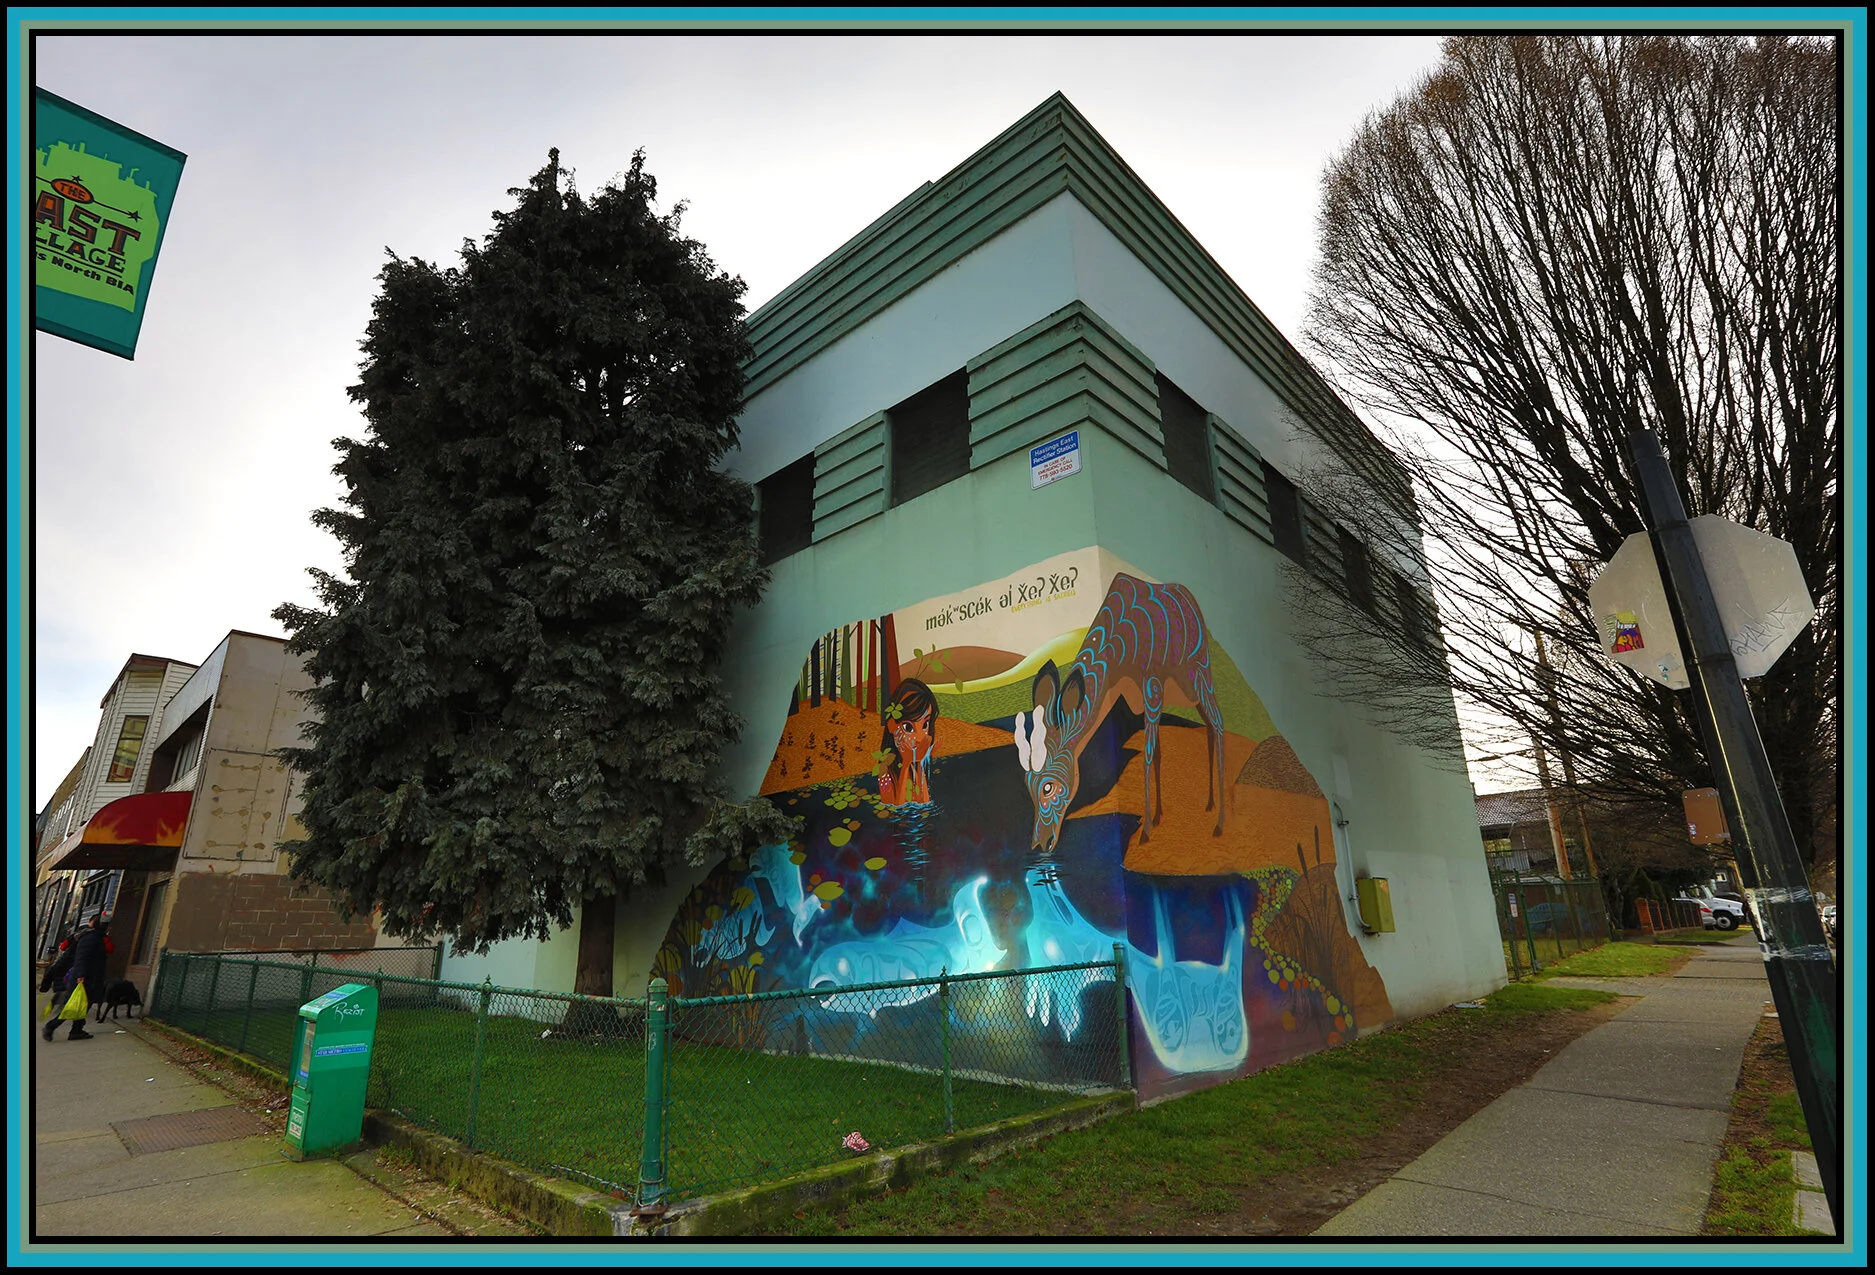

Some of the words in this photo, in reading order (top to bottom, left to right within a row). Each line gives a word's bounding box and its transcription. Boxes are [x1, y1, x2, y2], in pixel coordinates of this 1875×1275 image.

[60, 182, 86, 201] THE
[52, 256, 101, 281] North
[105, 275, 134, 295] BIA
[1034, 442, 1060, 457] Hastings
[1060, 435, 1074, 446] East
[1056, 442, 1077, 455] Station
